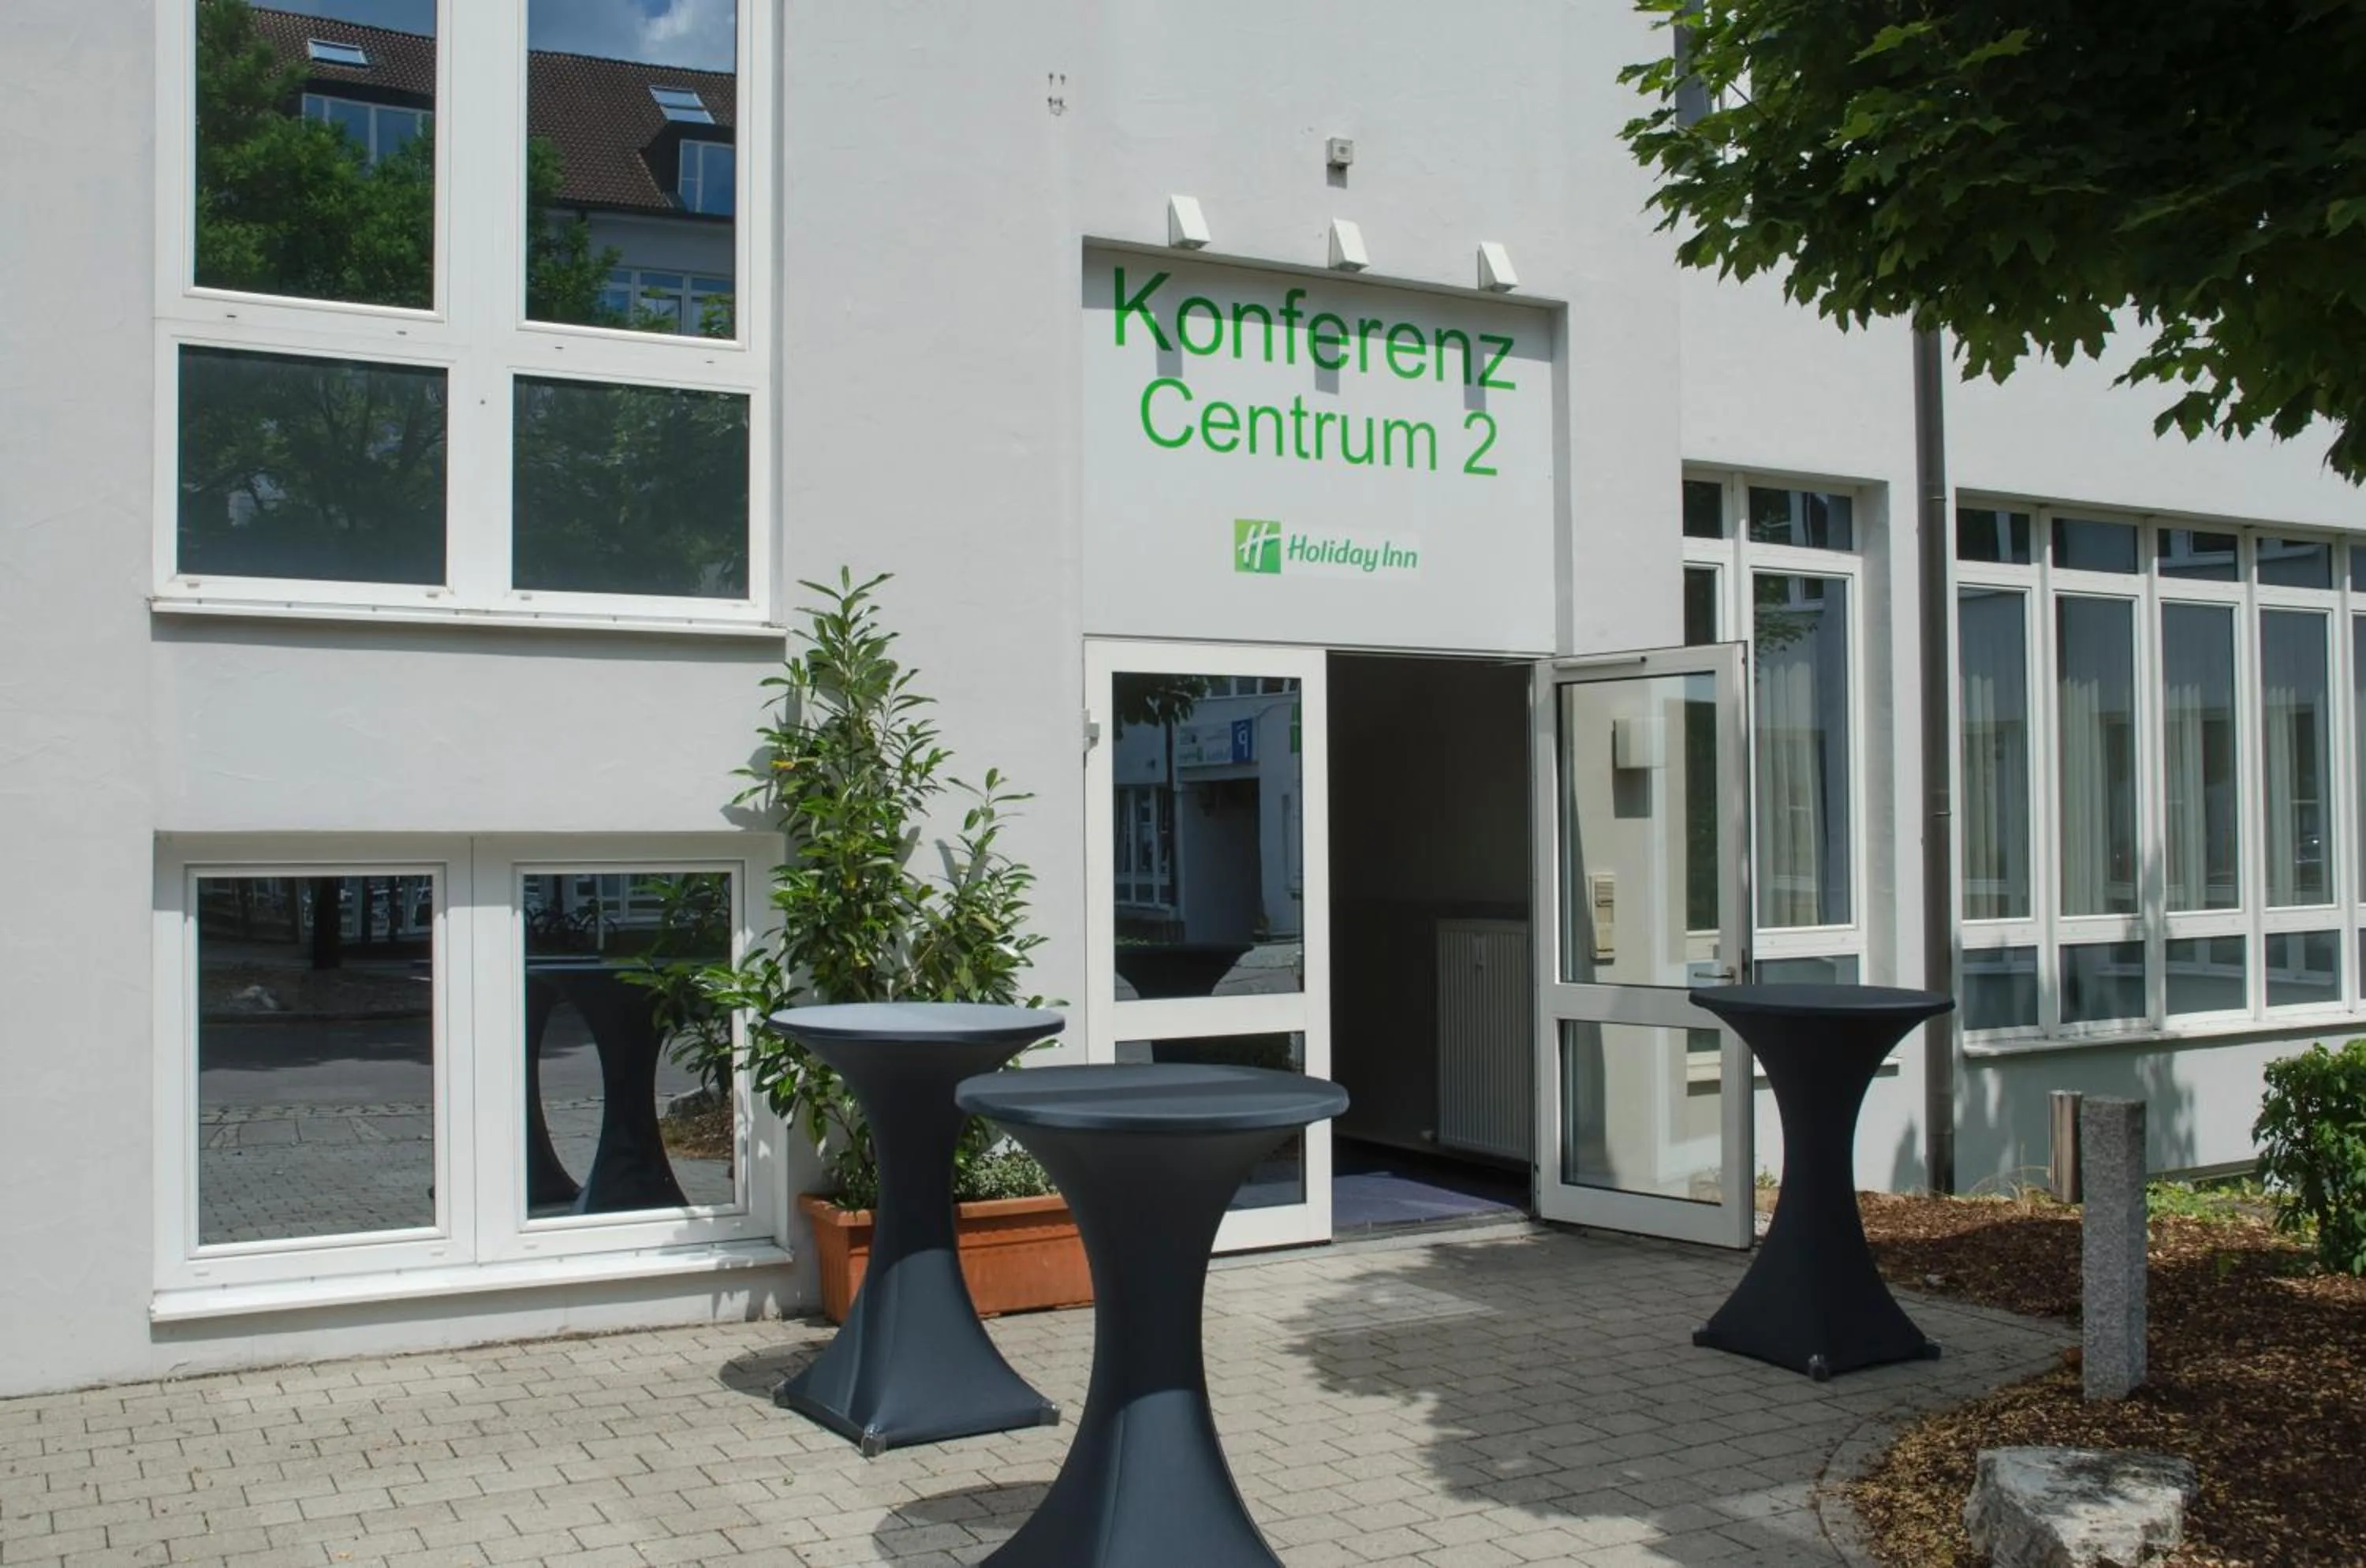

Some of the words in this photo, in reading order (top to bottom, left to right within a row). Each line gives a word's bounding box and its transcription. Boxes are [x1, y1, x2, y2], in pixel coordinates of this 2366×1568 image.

[1113, 265, 1517, 391] Konferenz
[1140, 376, 1438, 472] Centrum
[1462, 409, 1498, 477] 2
[1288, 533, 1379, 573] Holiday
[1383, 540, 1417, 569] Inn
